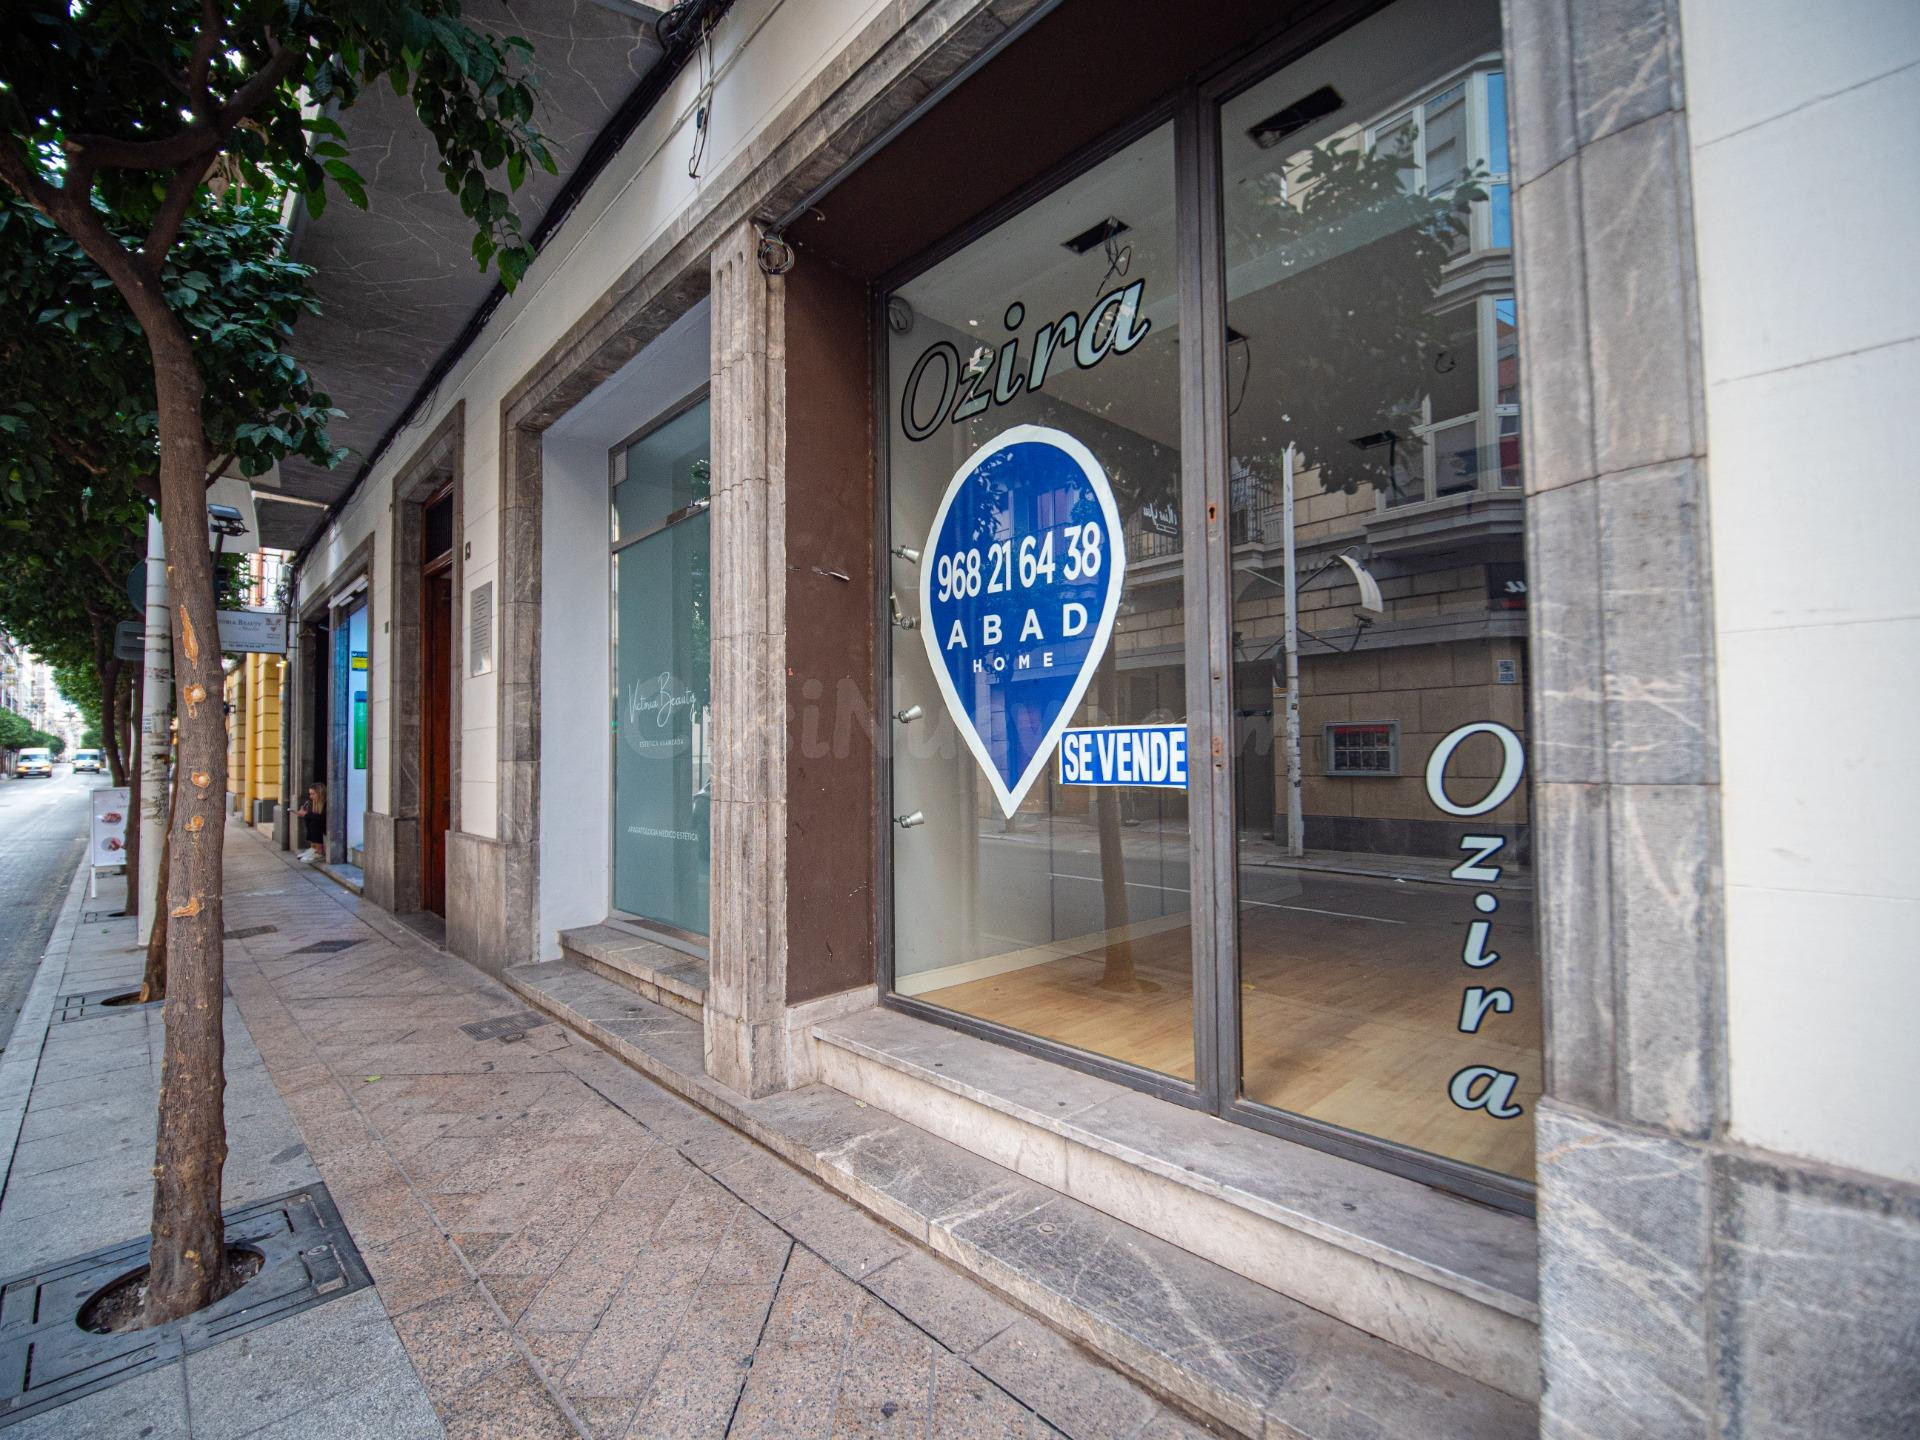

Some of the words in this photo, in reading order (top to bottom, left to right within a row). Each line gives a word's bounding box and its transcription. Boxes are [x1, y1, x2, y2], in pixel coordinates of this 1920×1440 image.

[901, 278, 1151, 442] Ozira
[938, 548, 982, 603] 968
[987, 541, 1012, 594] 21
[1019, 531, 1056, 588] 64
[1063, 521, 1101, 581] 38
[947, 602, 1088, 650] ABAD
[973, 652, 1053, 673] HOME
[629, 680, 659, 724] Victoria
[657, 672, 697, 727] Beauty
[1064, 733, 1094, 781] SE
[1096, 731, 1187, 782] VENDE
[1425, 720, 1526, 1119] Ozira
